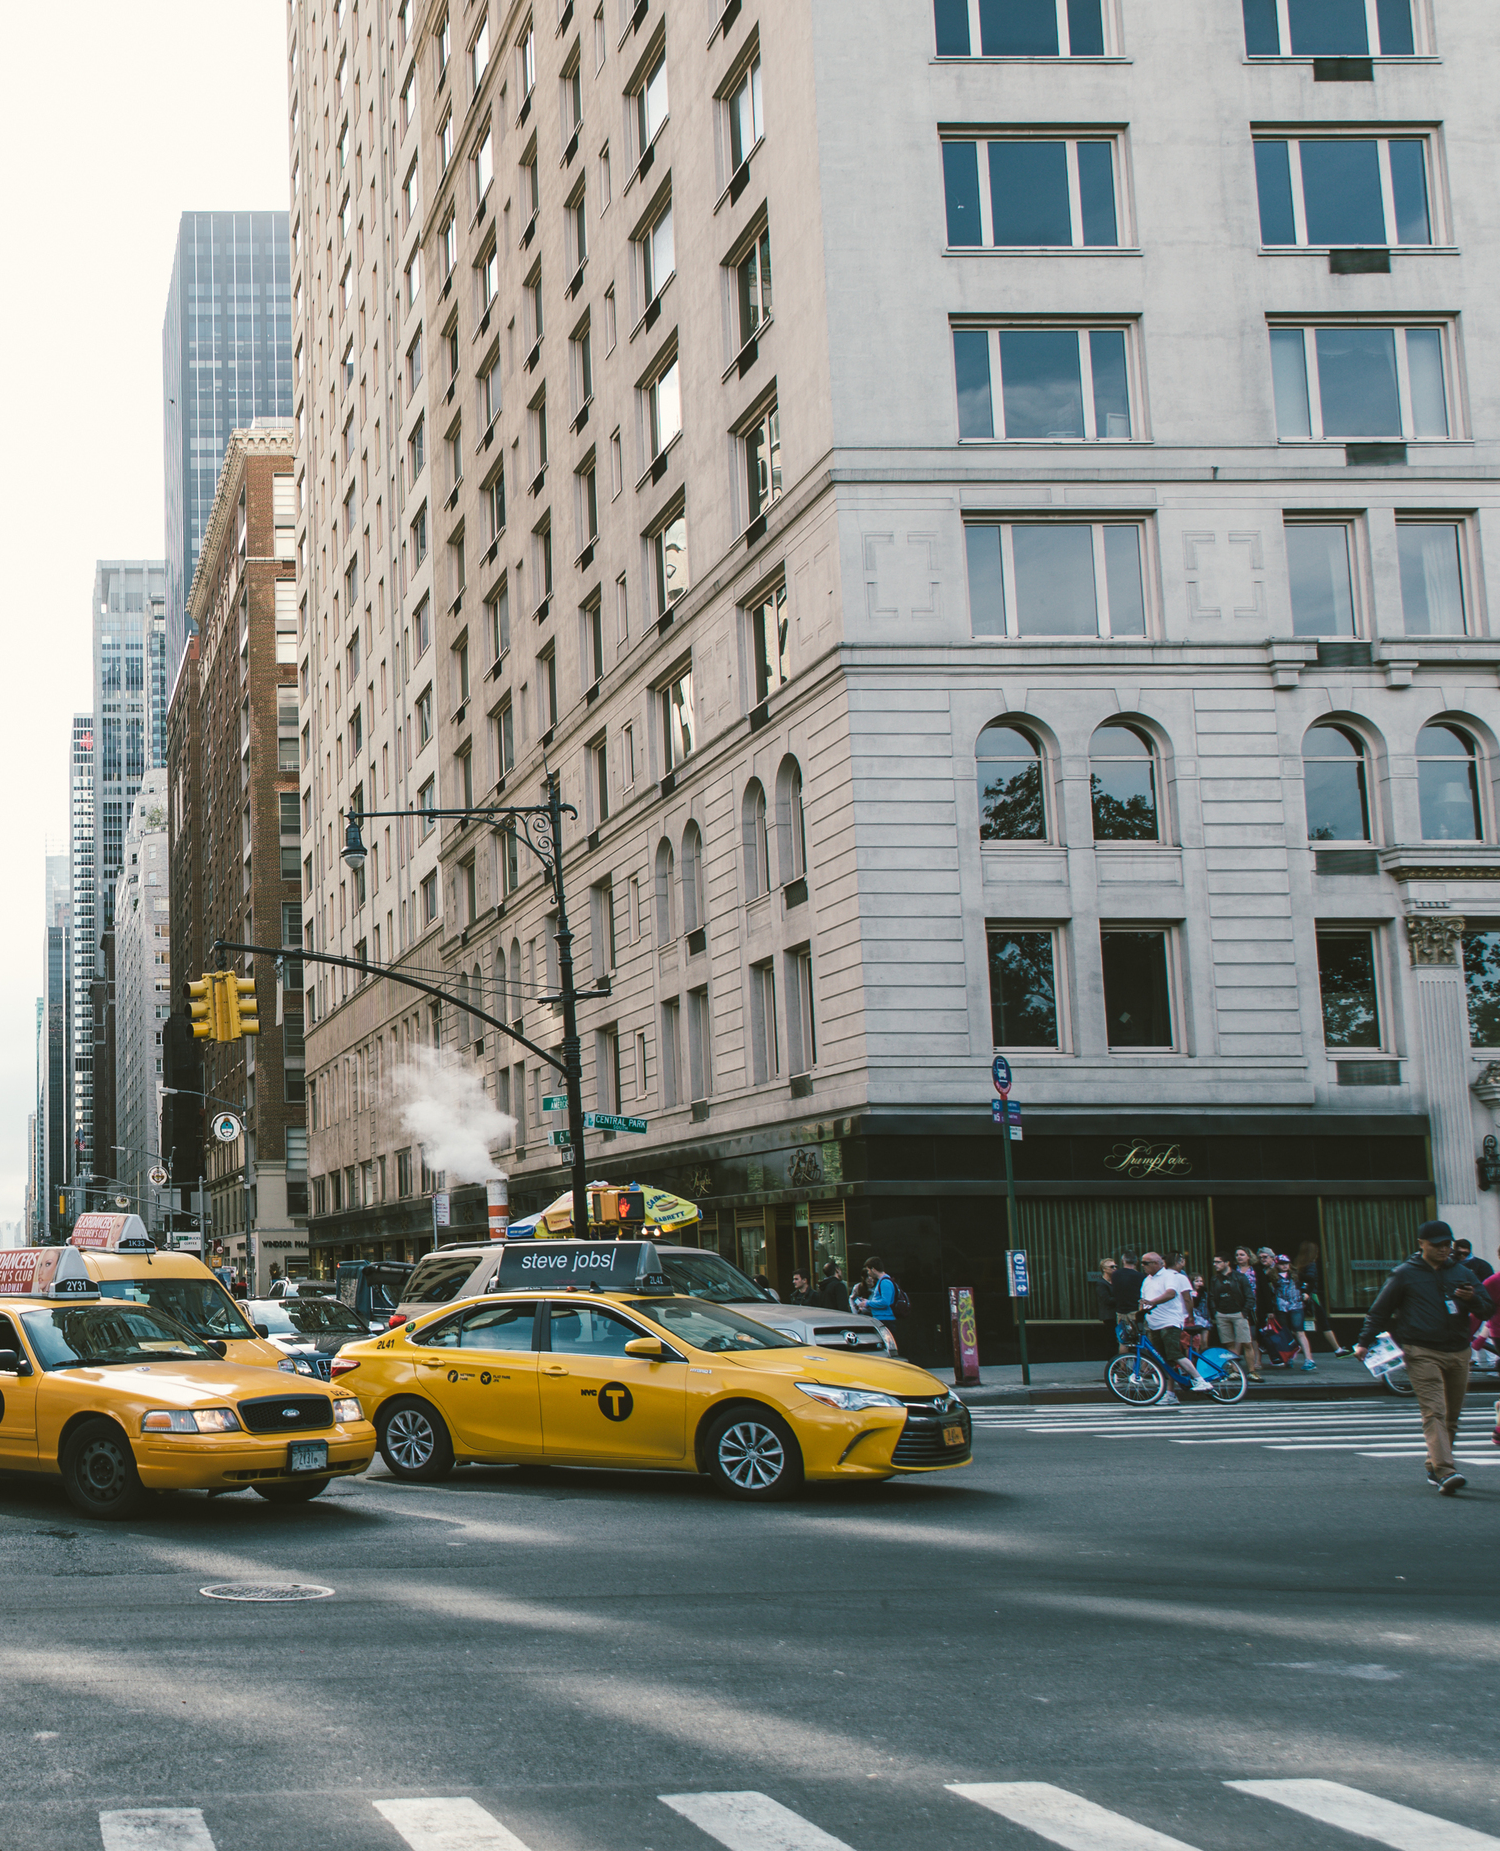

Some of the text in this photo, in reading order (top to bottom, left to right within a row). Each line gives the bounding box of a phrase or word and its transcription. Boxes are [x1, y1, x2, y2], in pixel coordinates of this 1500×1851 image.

[596, 1116, 646, 1128] CENTRAL PARK
[560, 1132, 565, 1143] 6
[654, 1211, 685, 1222] SABRETT
[76, 1216, 116, 1229] FLASHDANCERS
[98, 1230, 109, 1239] CLUB
[262, 1240, 292, 1249] WINDSOR
[521, 1253, 568, 1269] steve
[14, 1271, 34, 1282] CLUB
[66, 1281, 87, 1291] 2Y31
[376, 1339, 395, 1350] 2L41
[581, 1389, 626, 1417] NYC T
